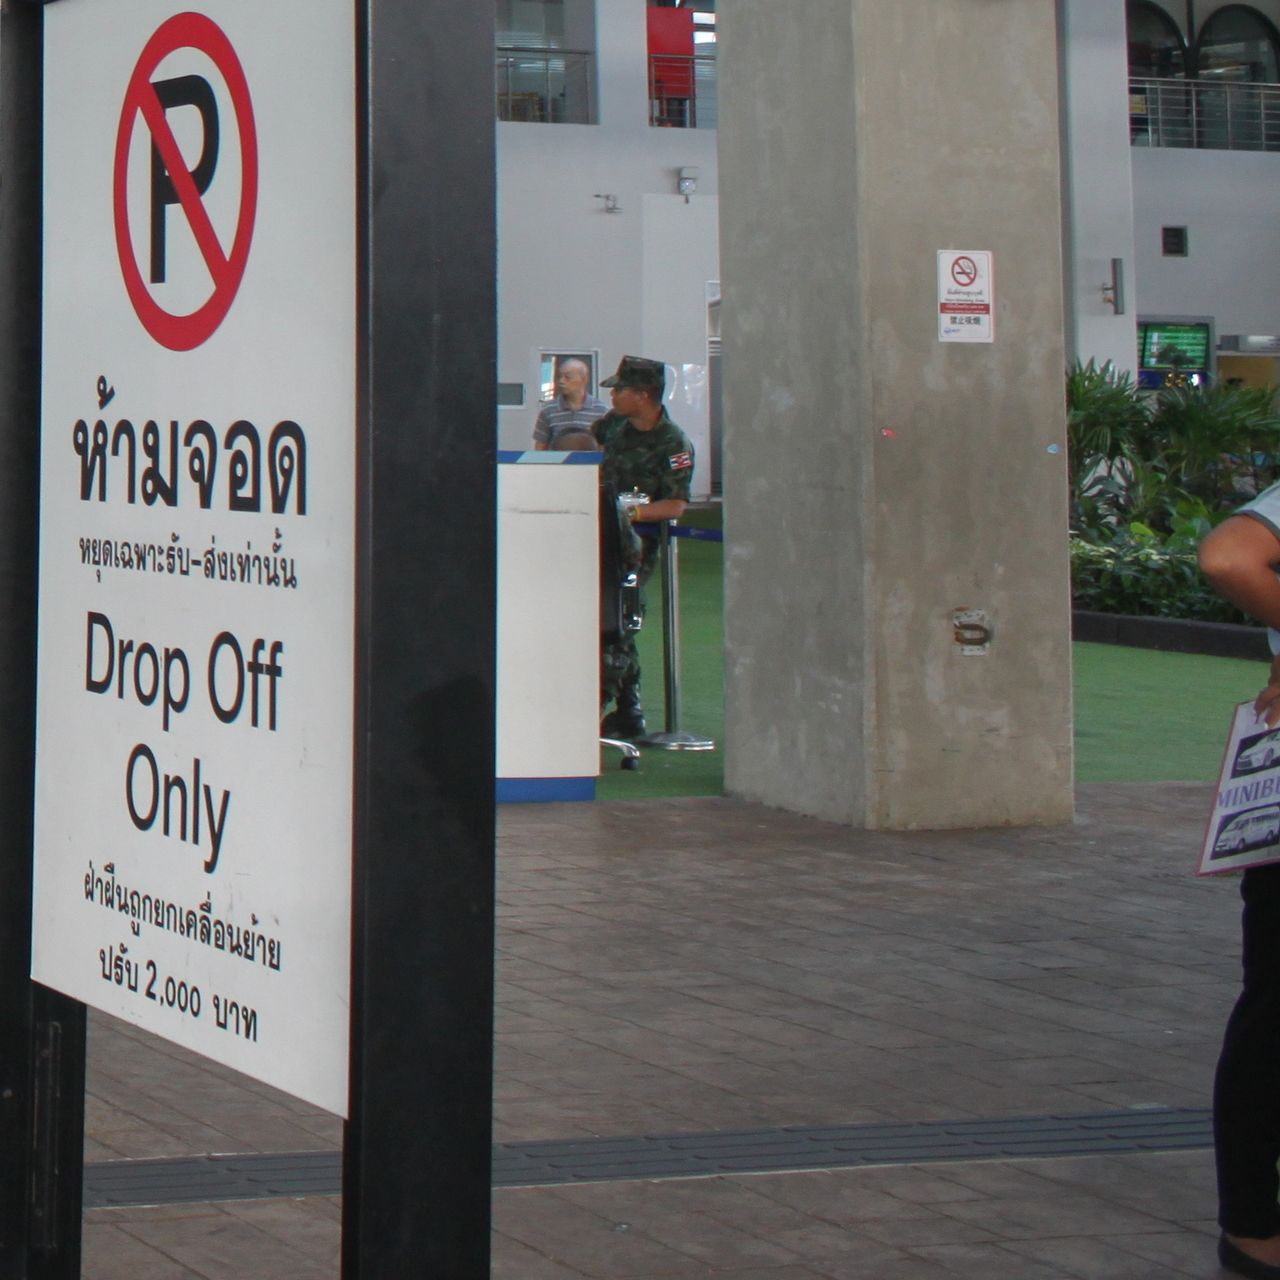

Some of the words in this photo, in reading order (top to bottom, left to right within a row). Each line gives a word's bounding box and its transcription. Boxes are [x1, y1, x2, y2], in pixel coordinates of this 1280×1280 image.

[72, 375, 307, 516] ห้ามจอด
[79, 527, 298, 589] หยุดเฉพาะรับ-ส่งเท่านั้น
[86, 611, 190, 732] Drop
[208, 631, 284, 731] Off
[126, 743, 230, 874] Only
[84, 860, 281, 971] ฝ่าฝืนถูกยกเคลื่อนย้าย
[99, 942, 139, 993] ปรับ
[145, 959, 201, 1018] 2,000
[213, 994, 258, 1043] บาท
